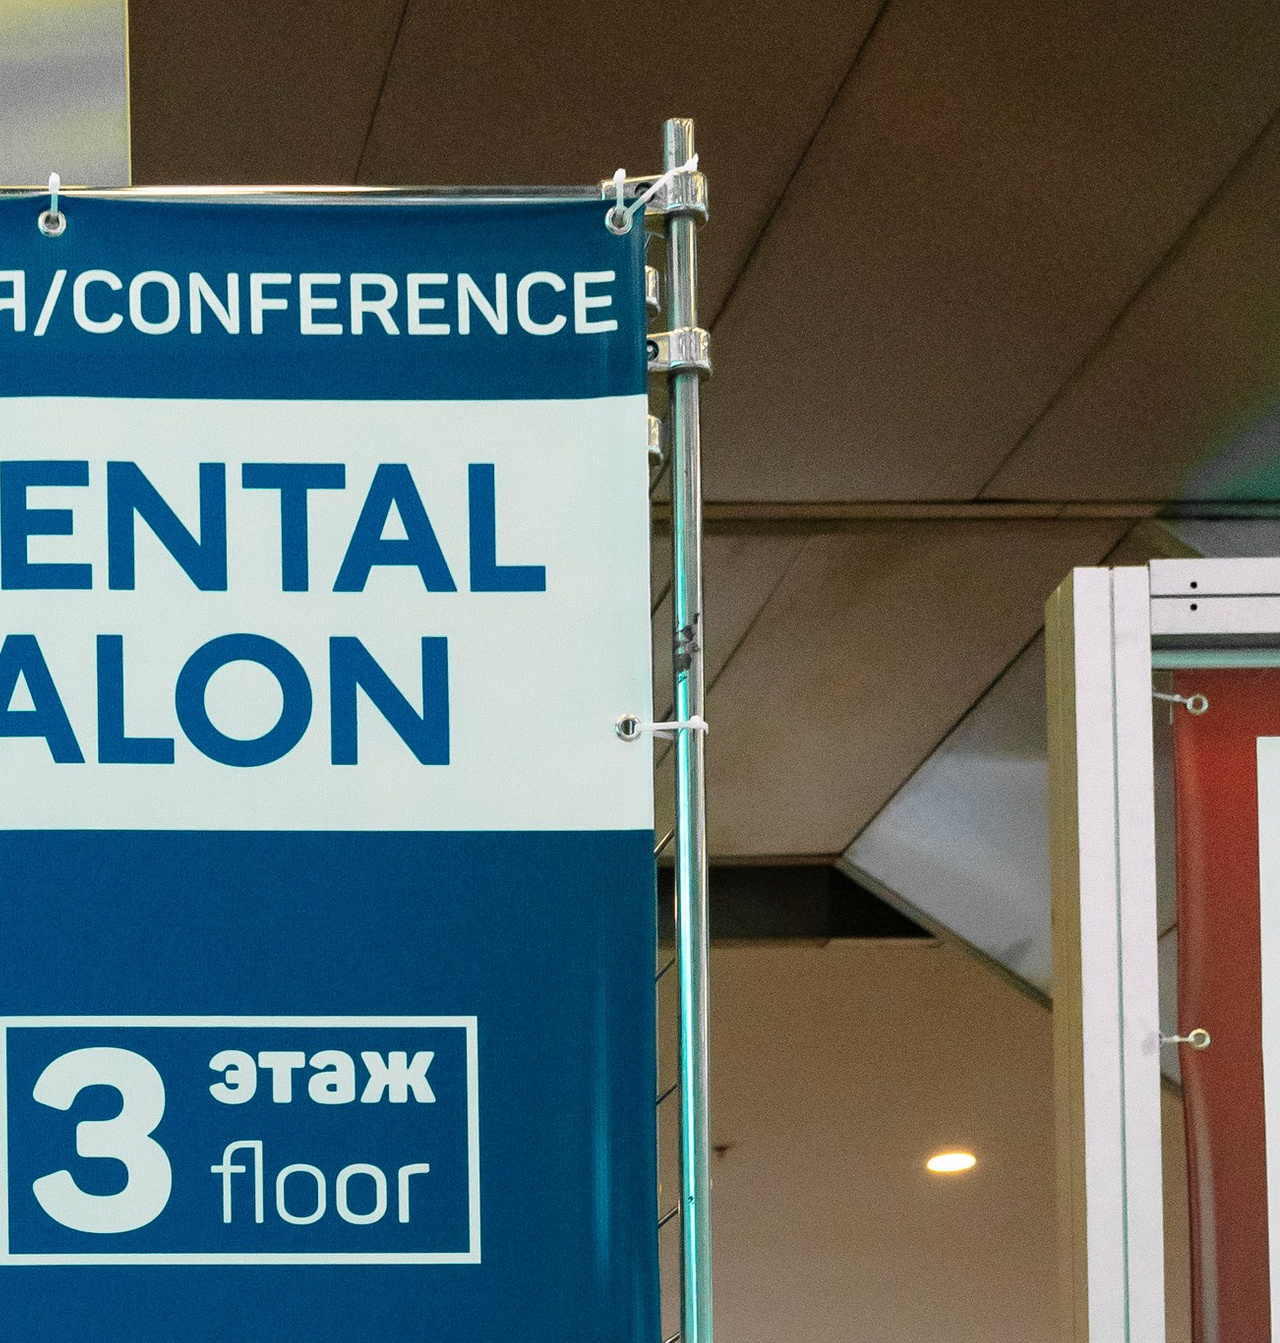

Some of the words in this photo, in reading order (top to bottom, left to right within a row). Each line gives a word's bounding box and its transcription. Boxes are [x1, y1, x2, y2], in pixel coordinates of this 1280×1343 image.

[210, 1050, 437, 1106] этаж
[33, 1047, 173, 1235] 3
[211, 1141, 431, 1226] floor
